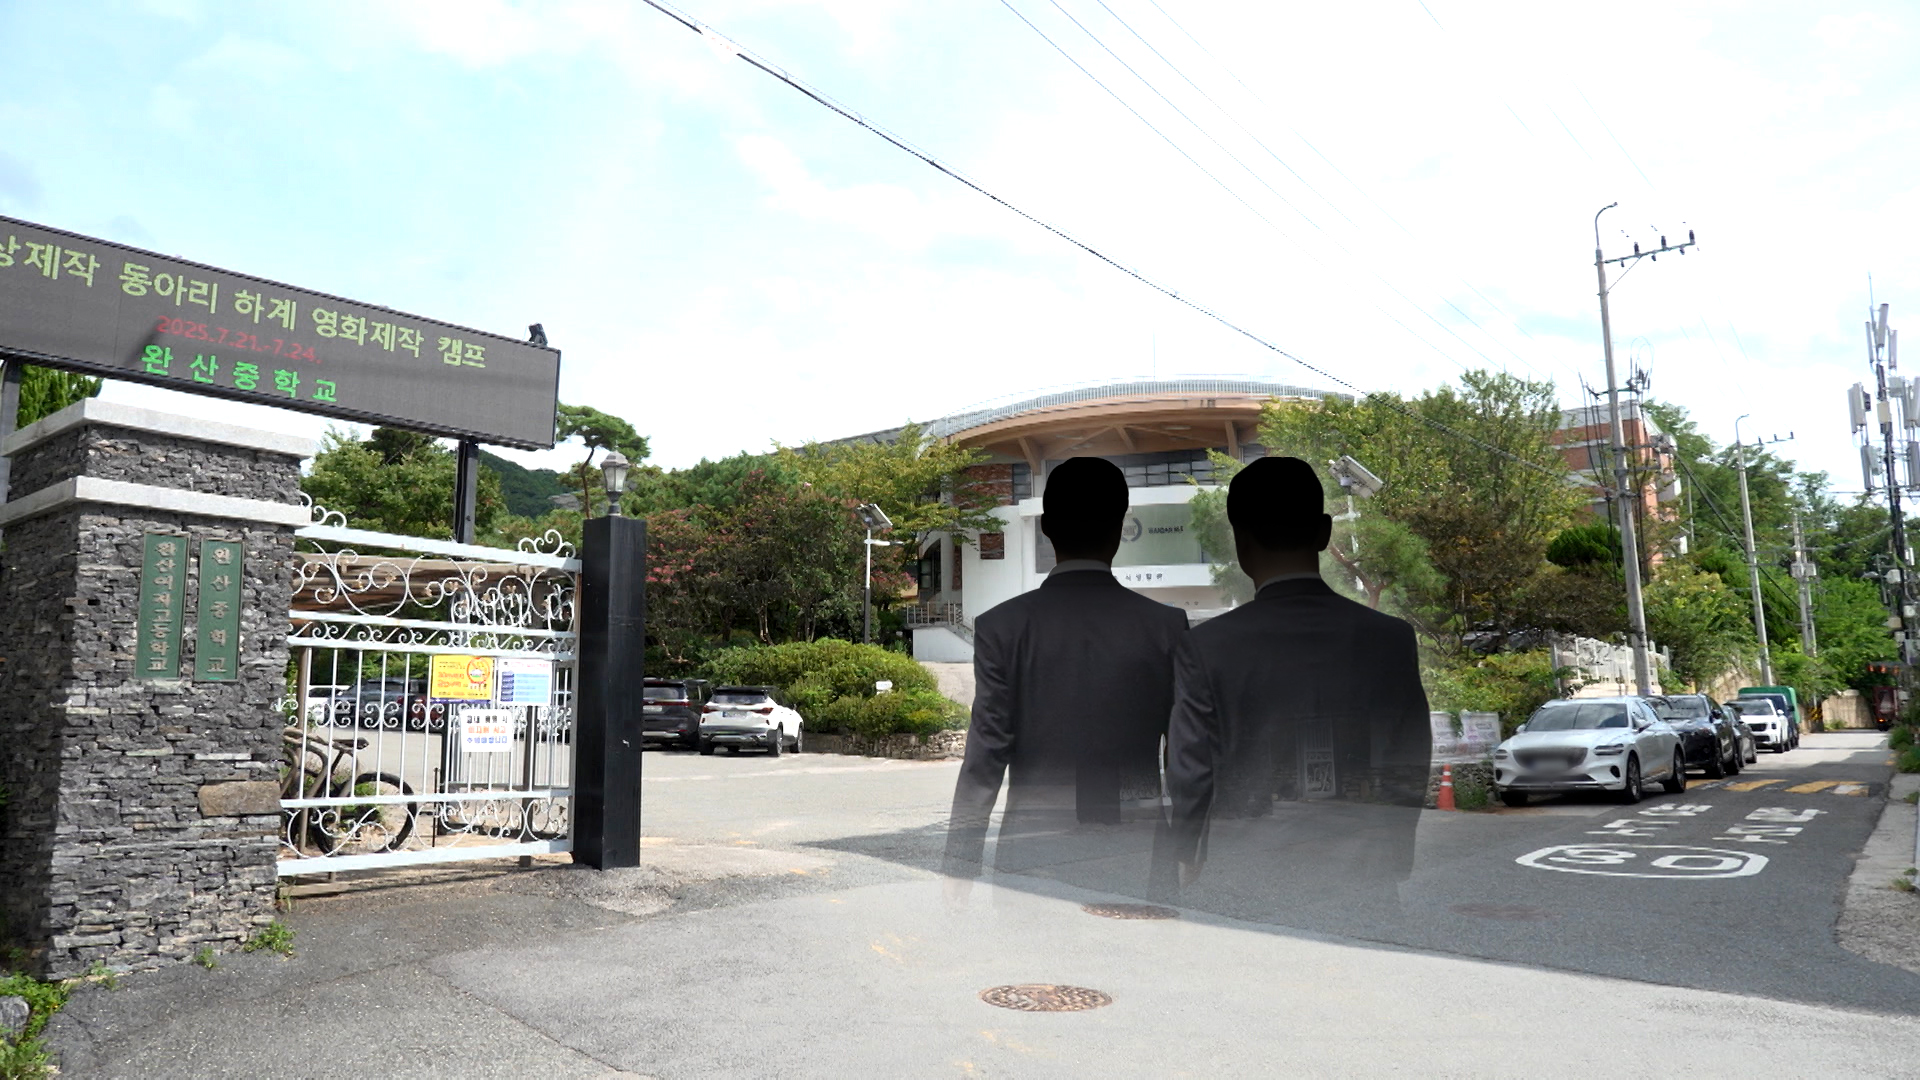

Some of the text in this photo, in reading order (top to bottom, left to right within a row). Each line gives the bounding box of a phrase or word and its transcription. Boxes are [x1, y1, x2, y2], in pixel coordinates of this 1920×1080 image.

[119, 262, 217, 314] 동아리
[234, 288, 297, 330] 하계
[312, 305, 425, 357] 영화제작
[437, 335, 487, 369] 캠프
[141, 344, 338, 403] 완산중학교
[147, 541, 177, 671] 완산여자고등학교
[207, 547, 233, 673] 완산중학교
[1547, 848, 1743, 870] 30
